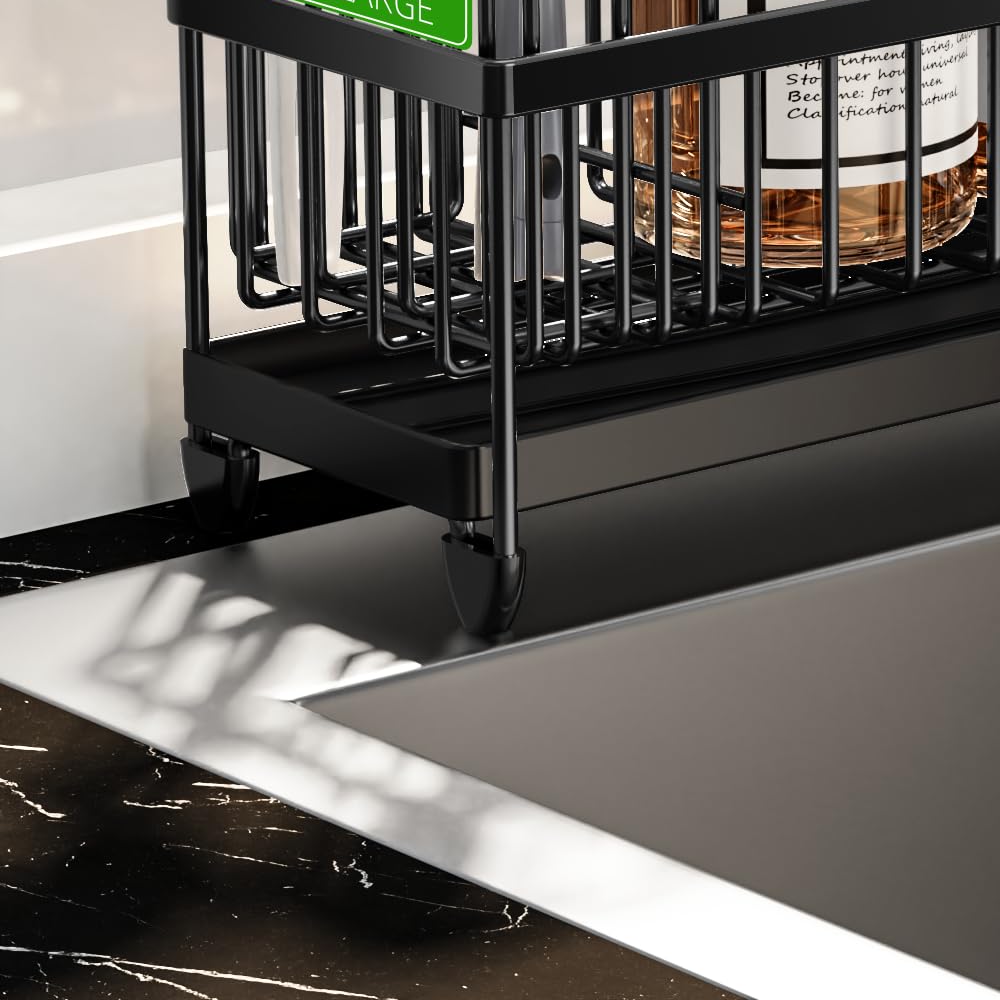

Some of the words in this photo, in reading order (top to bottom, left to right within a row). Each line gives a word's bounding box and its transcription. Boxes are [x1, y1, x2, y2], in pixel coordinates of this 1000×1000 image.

[920, 38, 954, 56] iving,
[786, 72, 871, 86] Stover
[922, 47, 969, 72] universal
[788, 89, 865, 103] Becme:
[871, 86, 894, 102] for
